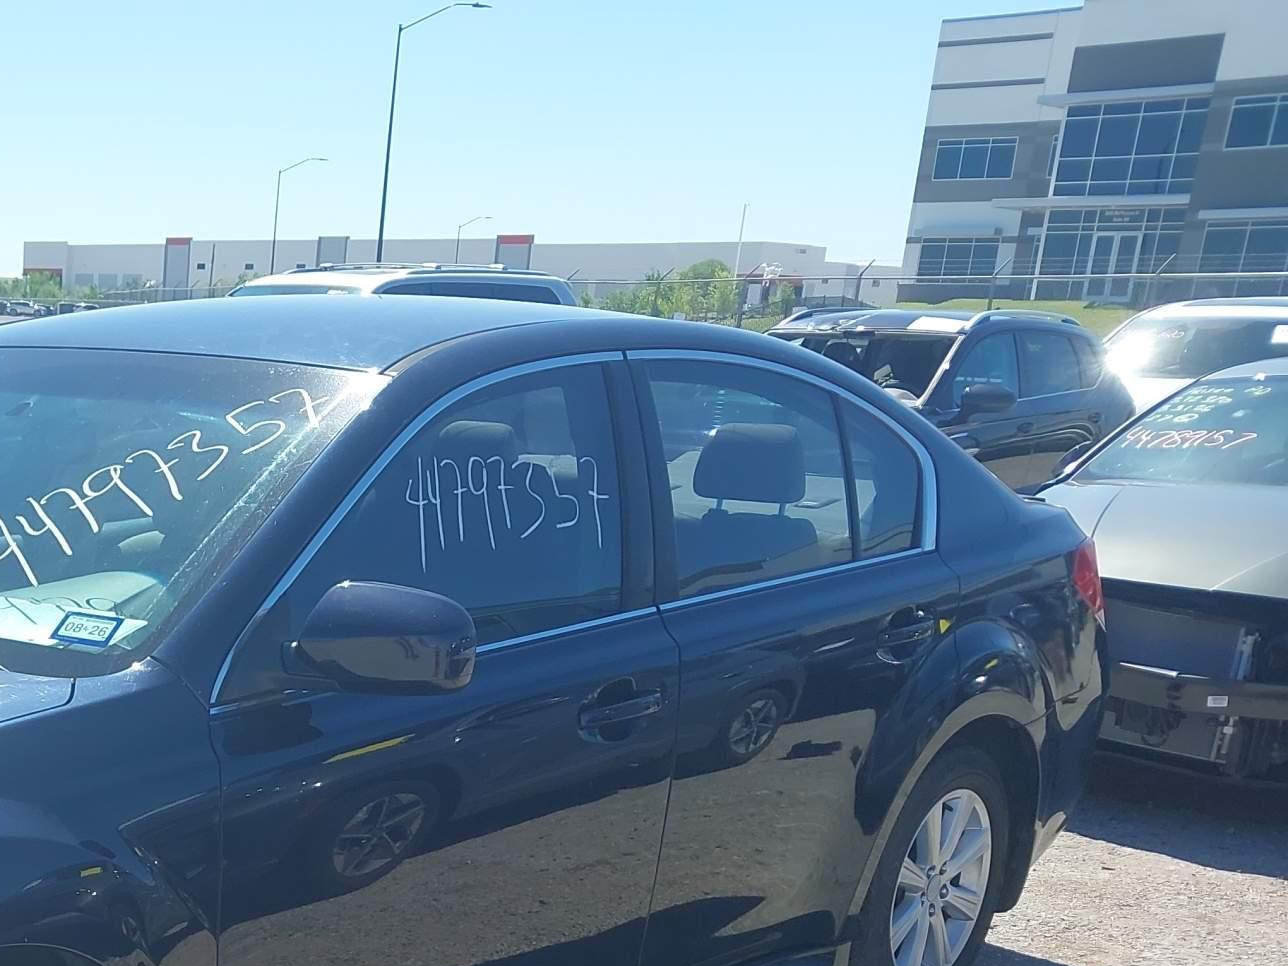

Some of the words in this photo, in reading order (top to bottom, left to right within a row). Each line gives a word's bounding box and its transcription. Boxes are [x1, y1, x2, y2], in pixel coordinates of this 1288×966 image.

[405, 456, 610, 573] 44797357
[64, 621, 83, 633] 08
[88, 625, 108, 637] 26
